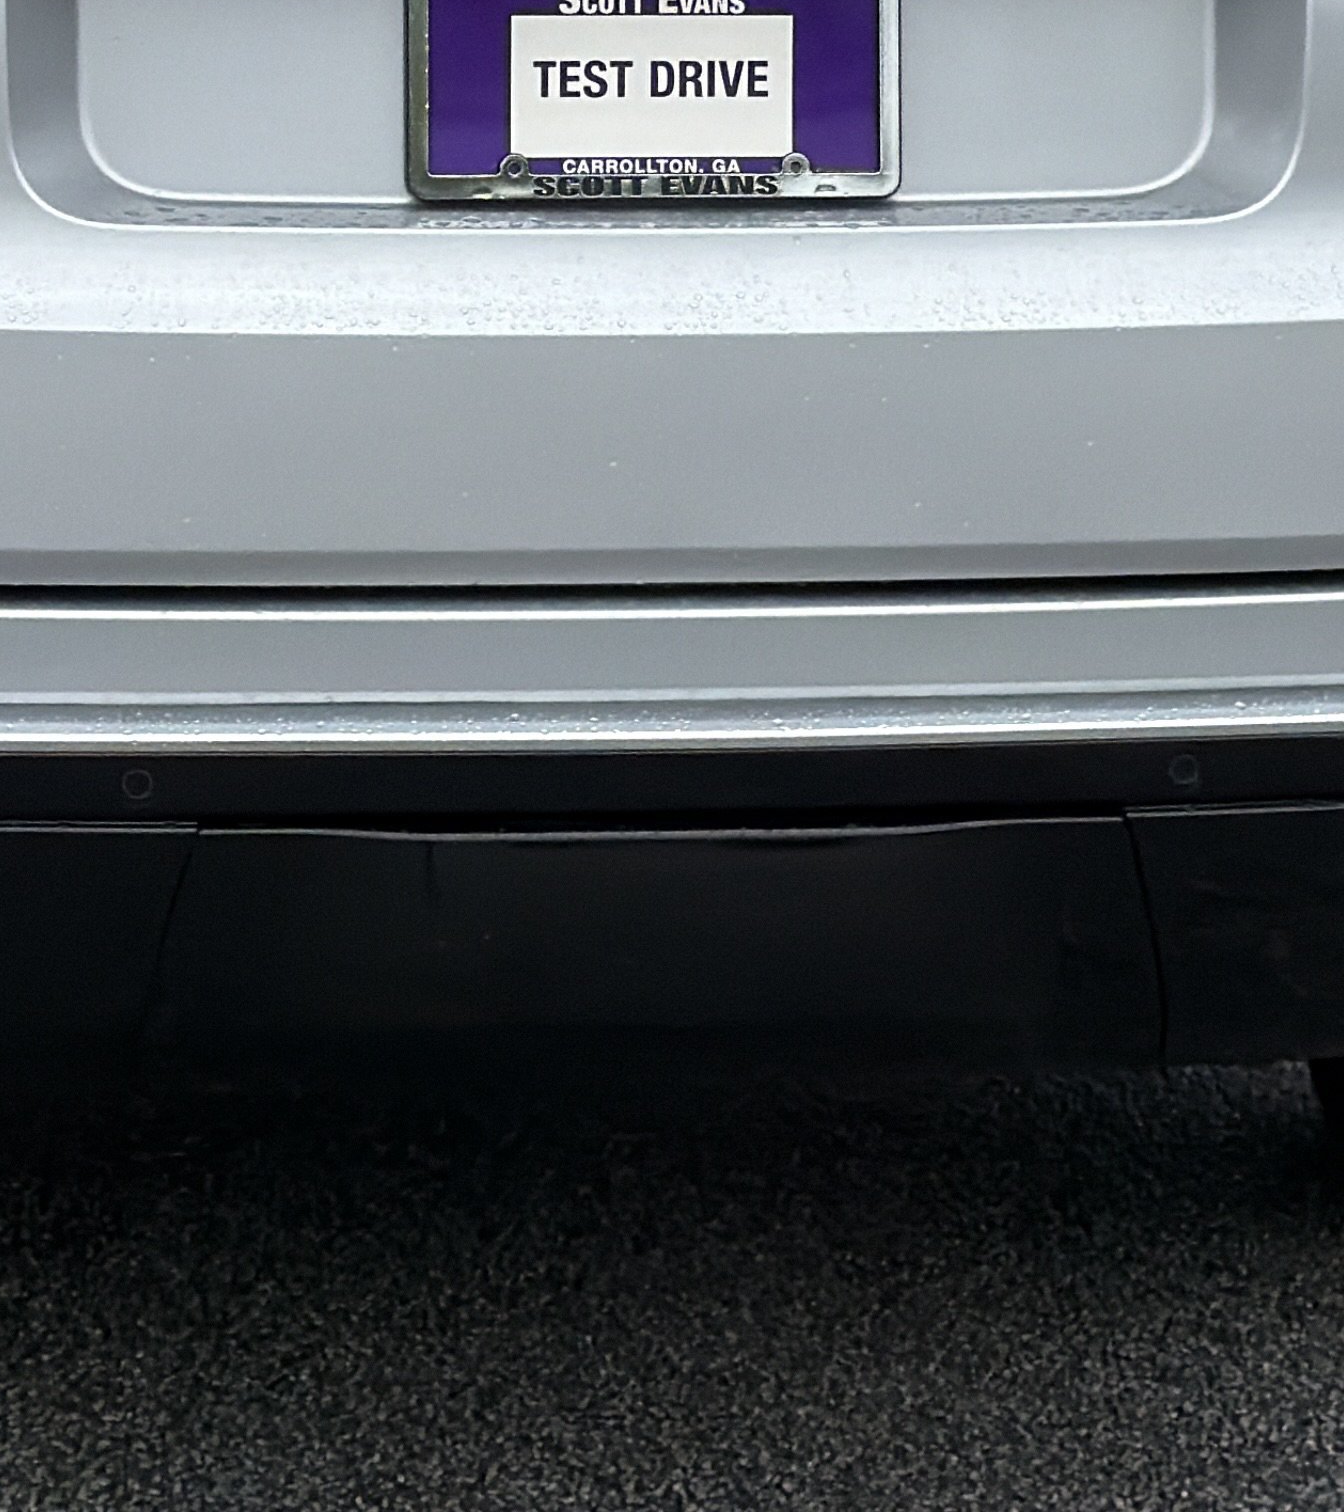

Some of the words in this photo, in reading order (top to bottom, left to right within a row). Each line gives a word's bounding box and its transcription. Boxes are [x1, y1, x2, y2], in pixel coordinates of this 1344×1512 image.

[533, 60, 633, 98] TEST
[650, 60, 768, 98] DRIVE
[712, 158, 741, 174] GA
[532, 175, 648, 197] SCOTT
[661, 175, 778, 196] EVANS
